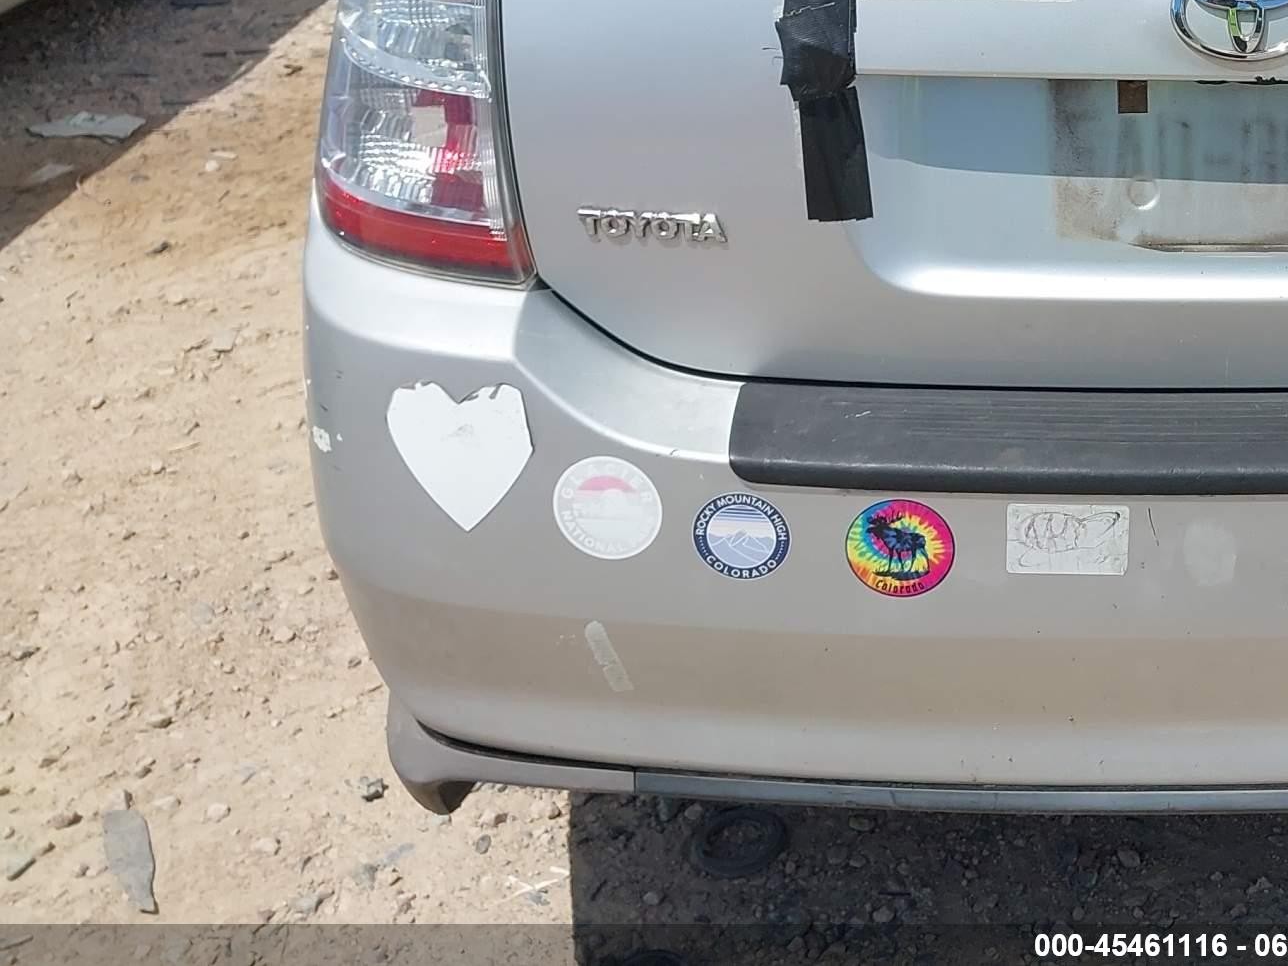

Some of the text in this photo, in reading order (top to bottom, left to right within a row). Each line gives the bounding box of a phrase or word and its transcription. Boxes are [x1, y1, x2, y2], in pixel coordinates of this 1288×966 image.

[577, 207, 728, 243] TOYOTA
[696, 494, 788, 540] ROCKY MOUNTAIN HIGH
[706, 558, 777, 579] COLORADO
[875, 579, 925, 594] Colorado
